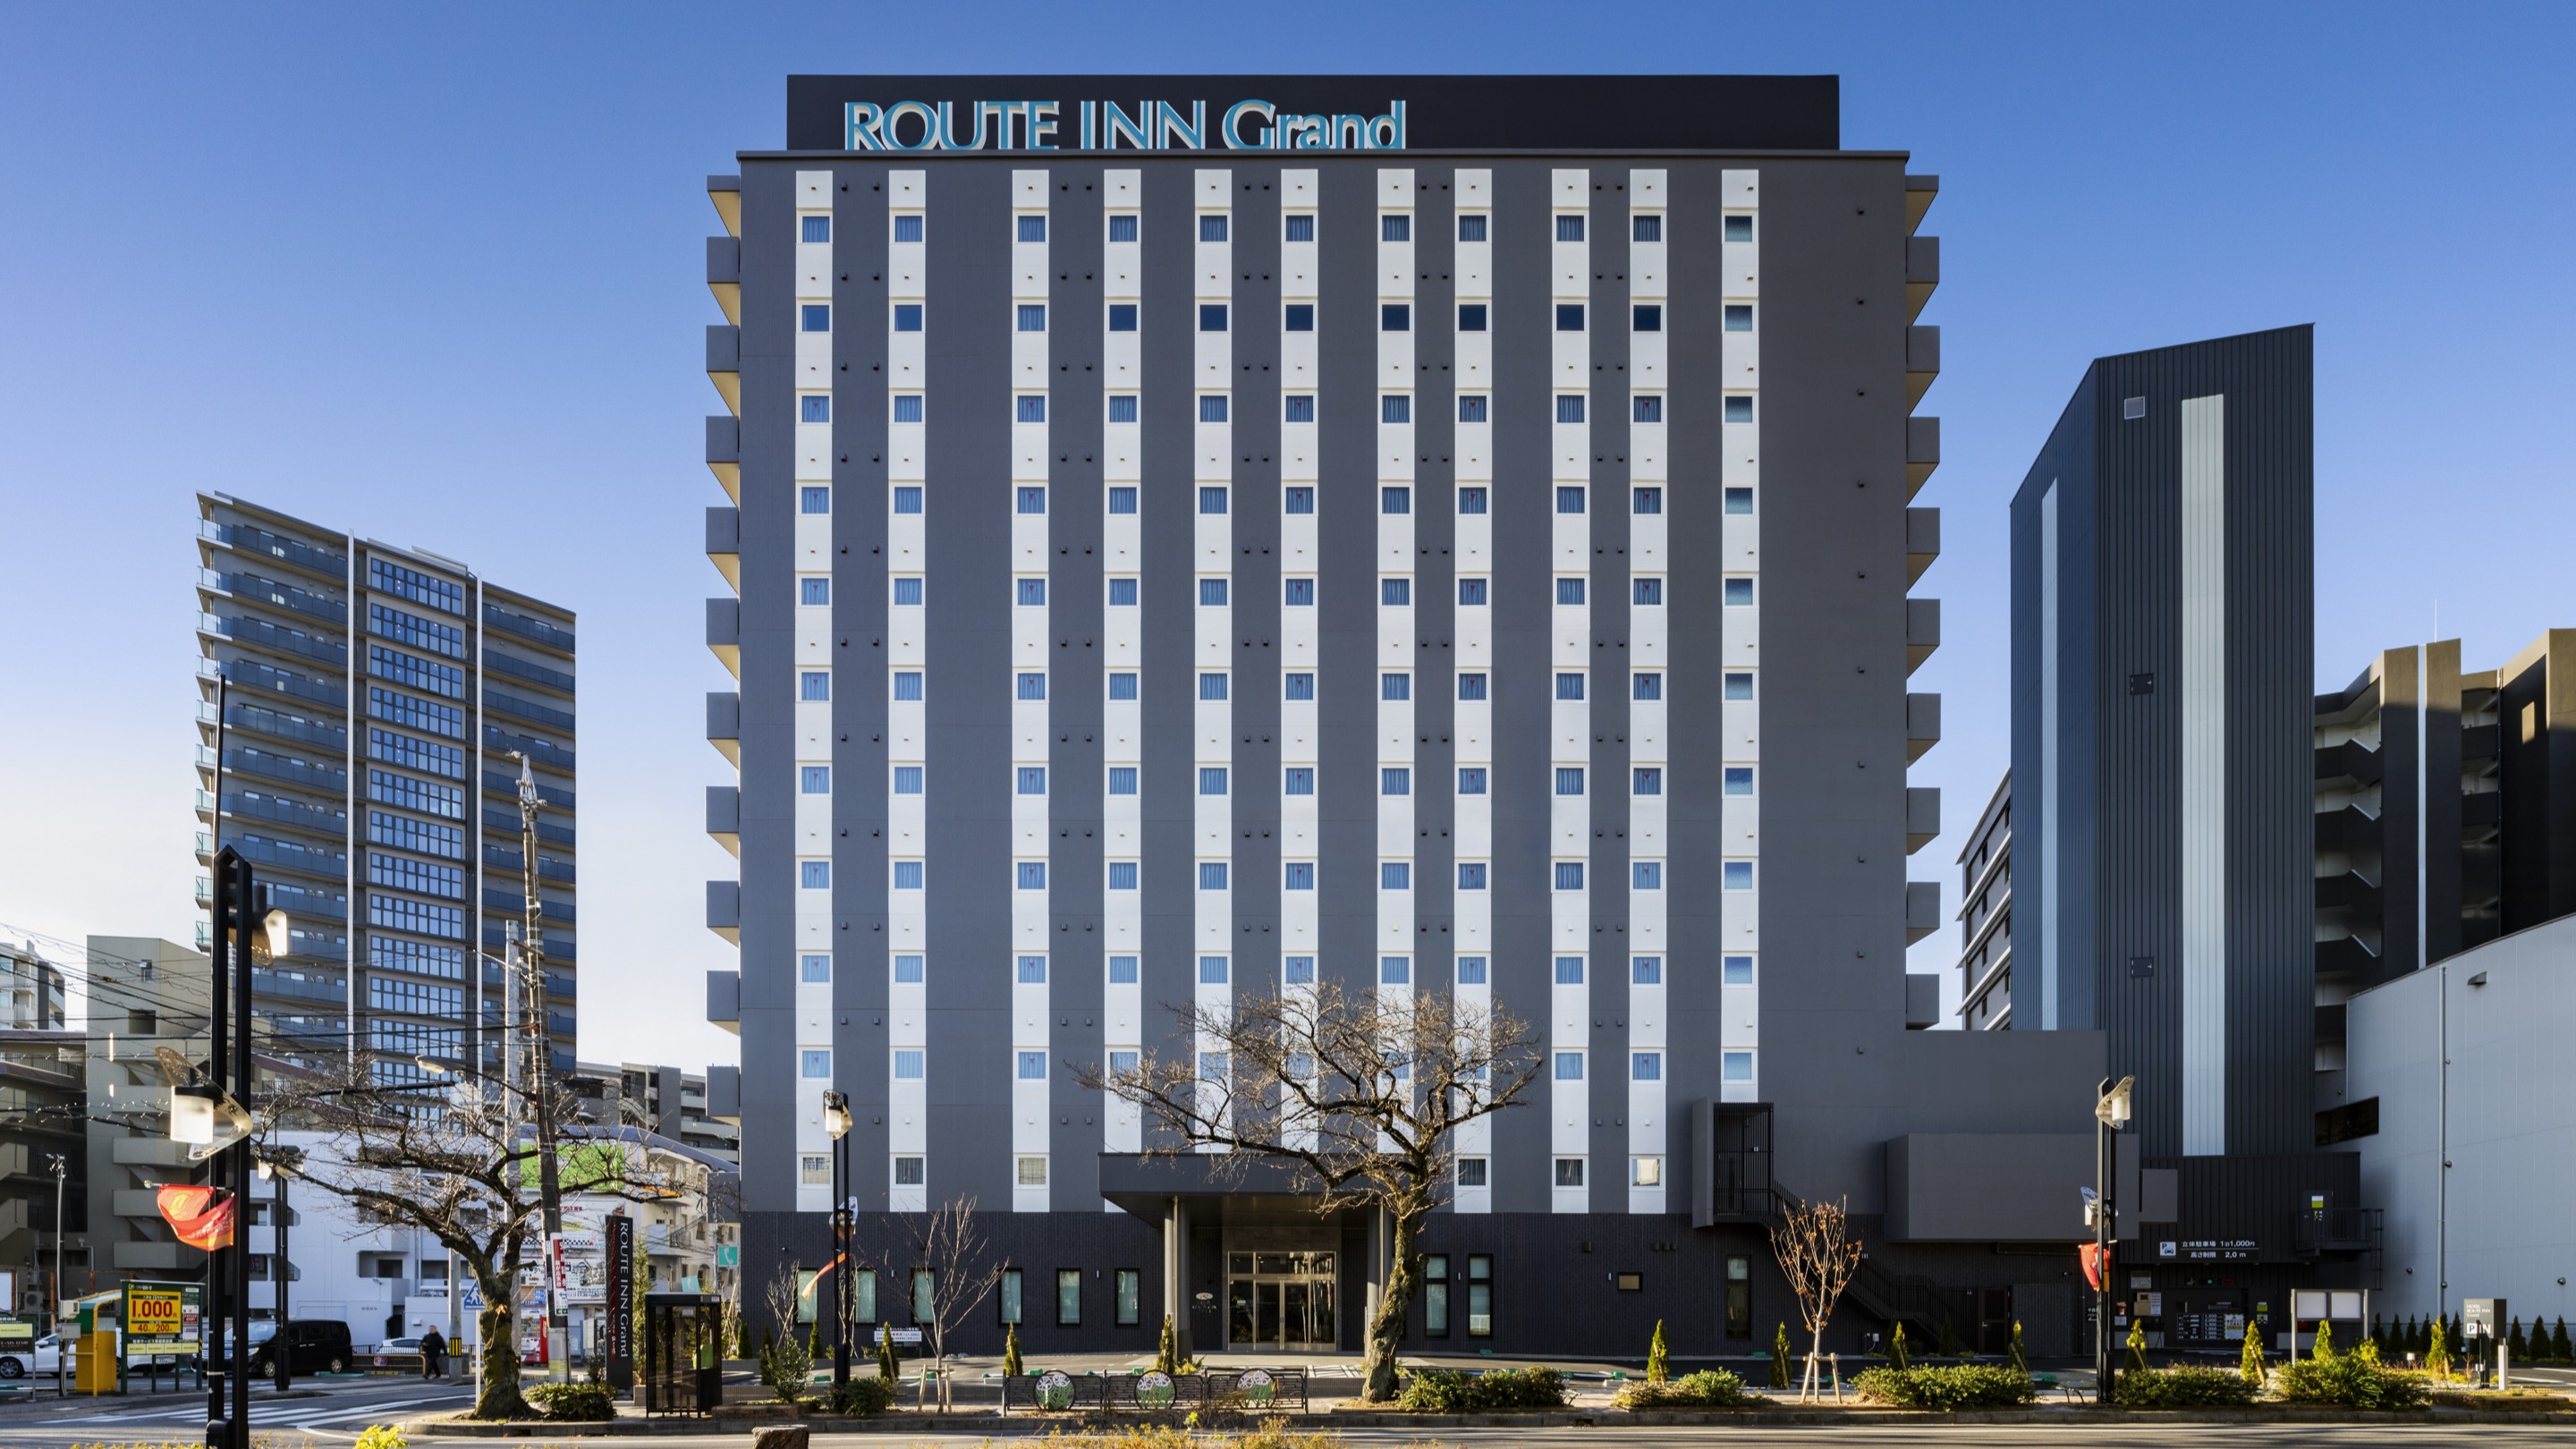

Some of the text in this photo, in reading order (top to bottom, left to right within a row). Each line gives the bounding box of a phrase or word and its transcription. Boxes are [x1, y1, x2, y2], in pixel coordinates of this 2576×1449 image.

[845, 98, 1407, 150] ROUTE INN Grand
[620, 1222, 629, 1358] ROUTE INN Grand
[2479, 1324, 2491, 1335] IN
